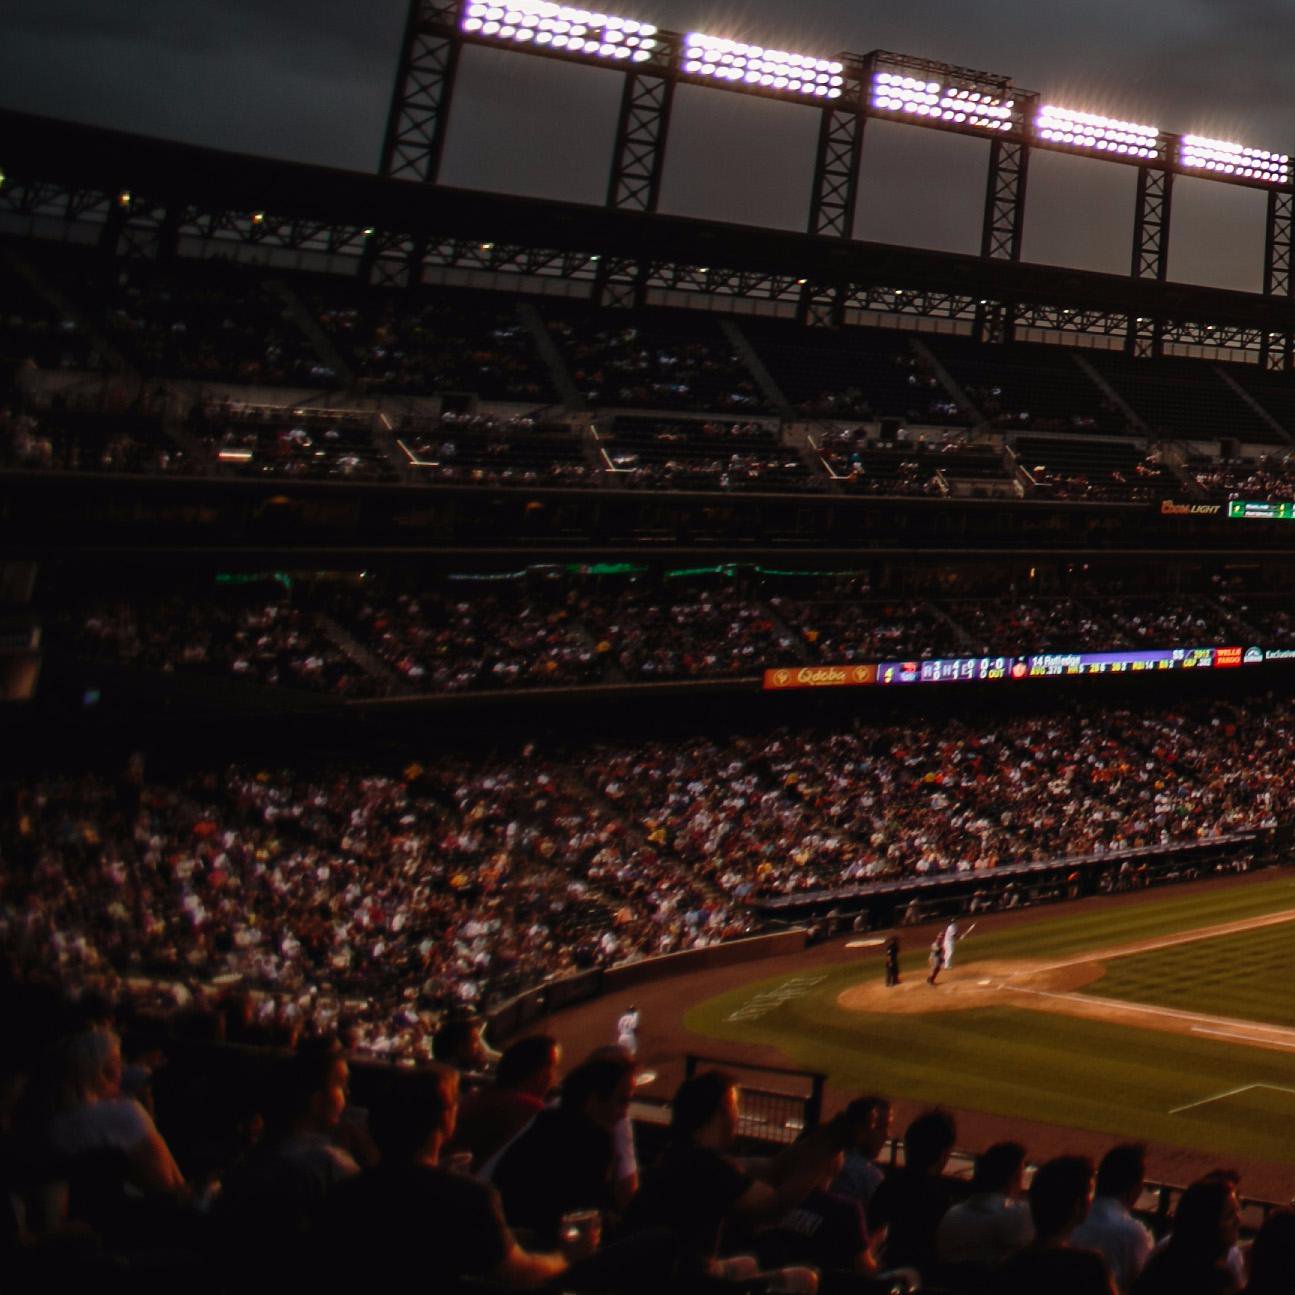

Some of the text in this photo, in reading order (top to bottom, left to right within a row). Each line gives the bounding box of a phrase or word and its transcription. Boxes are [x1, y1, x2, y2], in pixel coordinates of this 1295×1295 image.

[1190, 505, 1221, 514] LIGHT
[1217, 647, 1241, 656] WELLS
[797, 667, 847, 686] Qdoba
